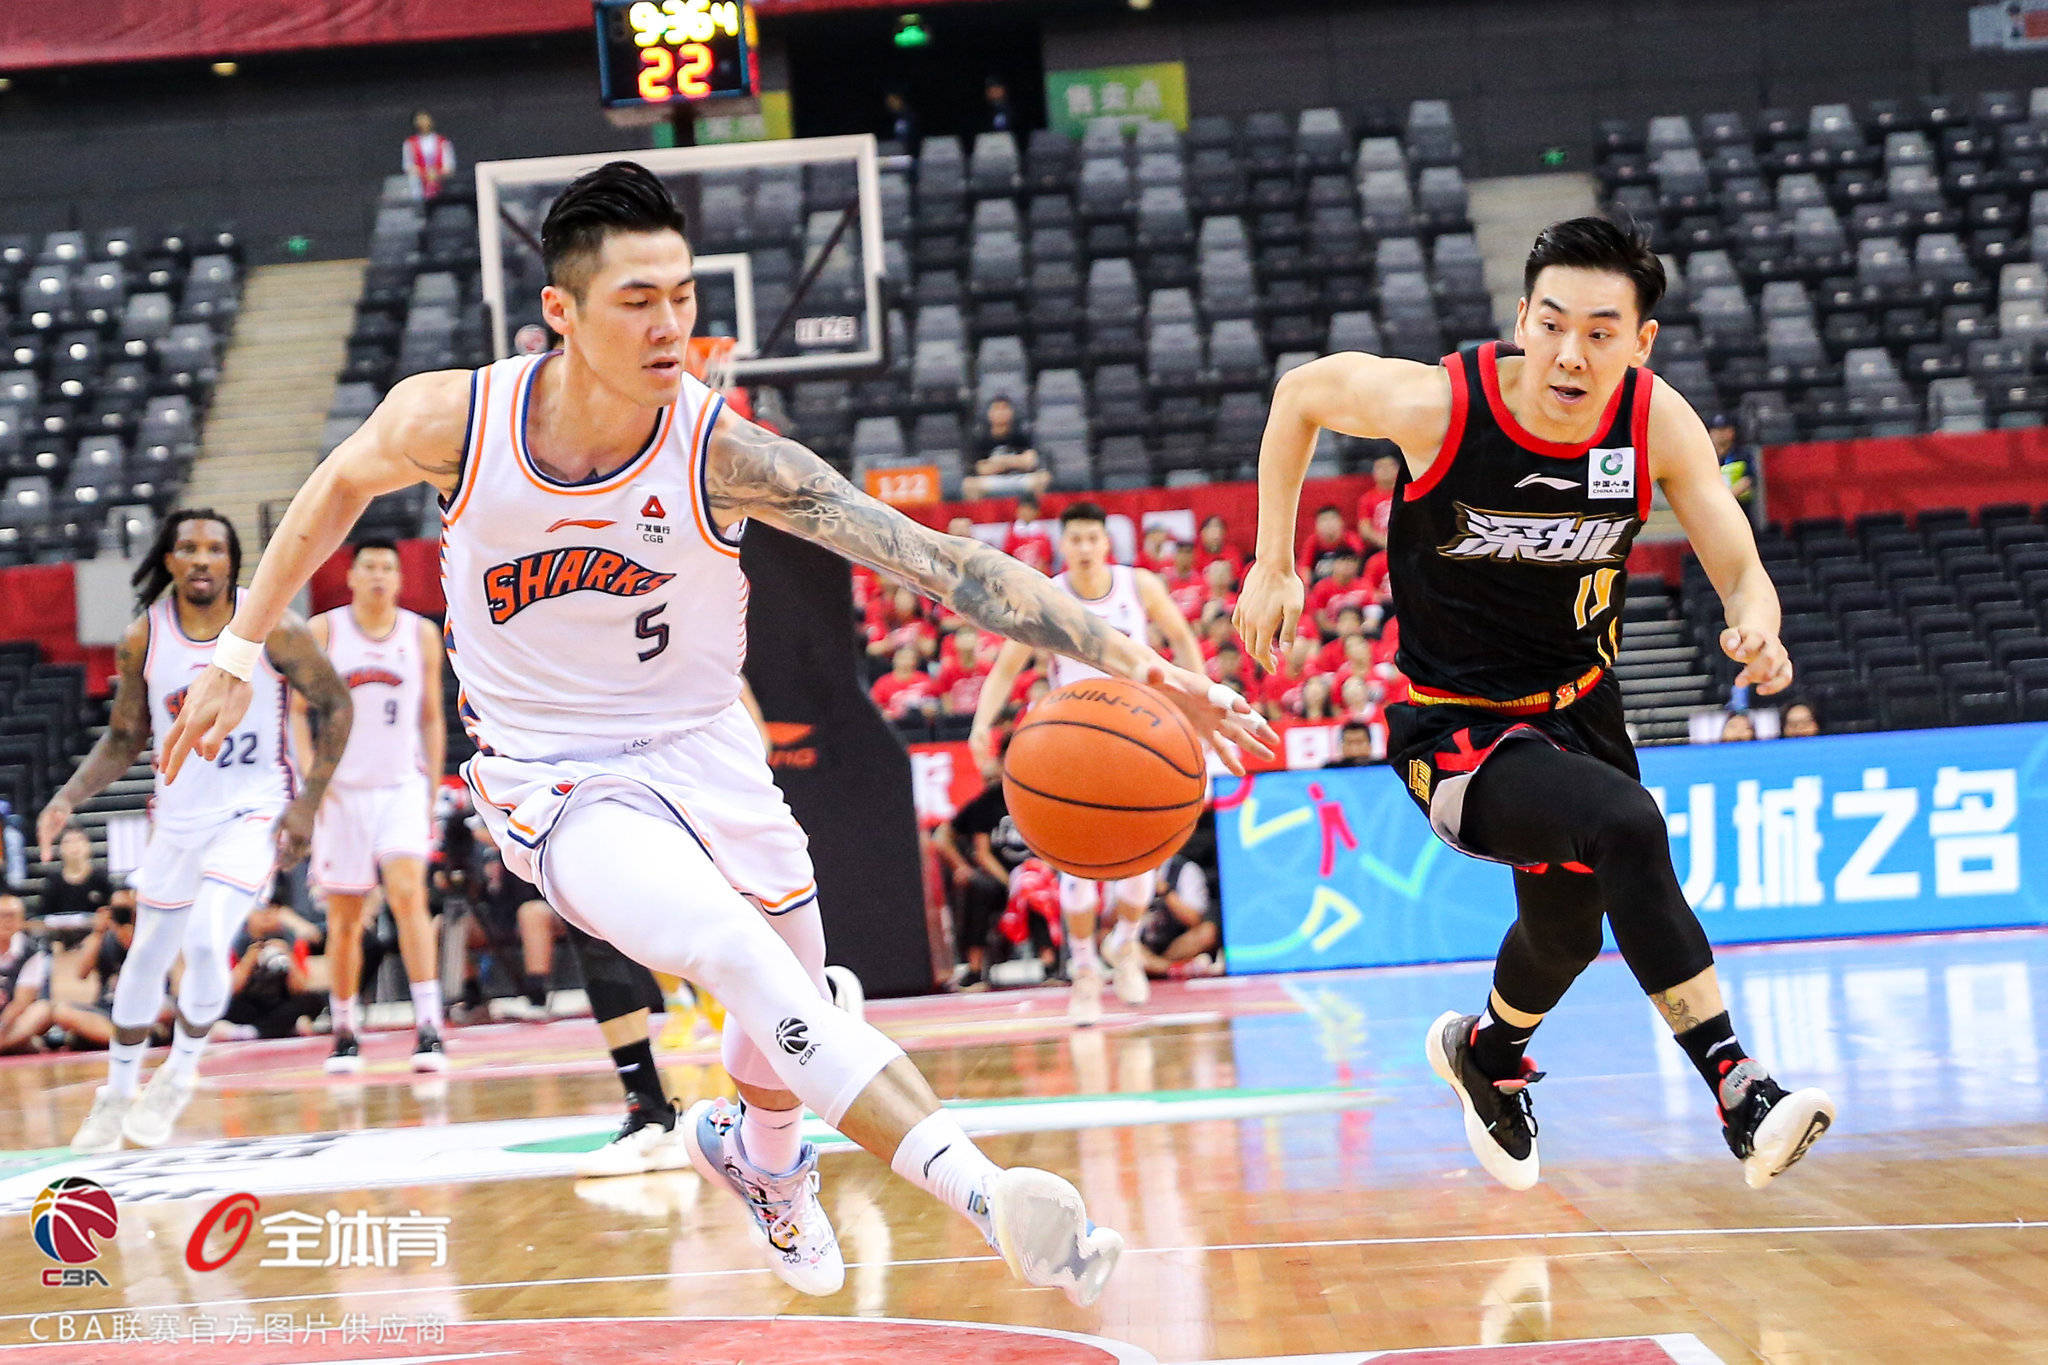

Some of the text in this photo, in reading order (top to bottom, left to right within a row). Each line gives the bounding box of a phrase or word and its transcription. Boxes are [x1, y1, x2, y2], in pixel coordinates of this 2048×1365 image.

[638, 43, 713, 102] 22
[878, 474, 927, 500] 122
[642, 533, 664, 544] CGB
[1446, 509, 1634, 561] 深圳
[484, 546, 677, 624] SHARKS
[635, 602, 670, 662] 5
[384, 700, 397, 725] 9
[217, 731, 259, 768] 22
[799, 1043, 822, 1066] CBA
